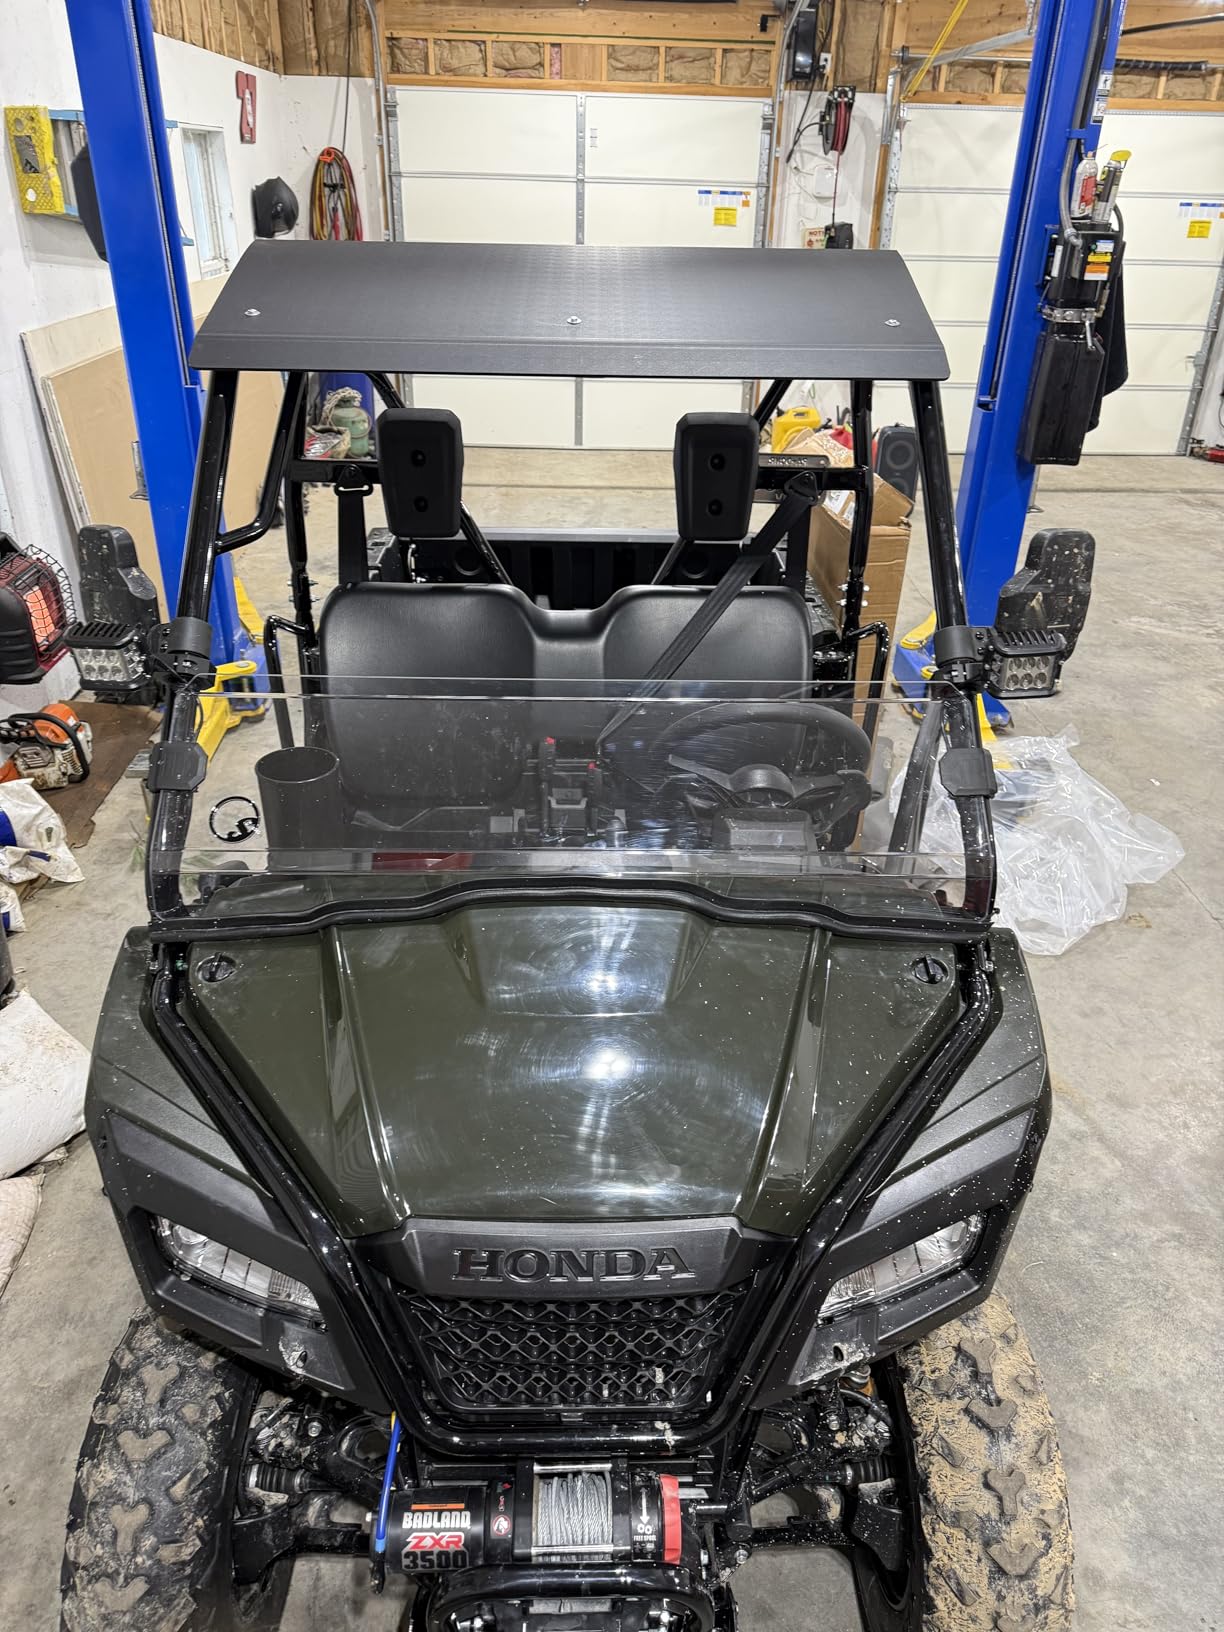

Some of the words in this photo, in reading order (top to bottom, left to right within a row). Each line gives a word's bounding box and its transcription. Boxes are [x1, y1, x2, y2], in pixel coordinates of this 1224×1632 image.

[451, 1247, 697, 1283] HONDA
[402, 1511, 470, 1529] BADLAND
[406, 1532, 465, 1551] ZXR
[403, 1551, 467, 1569] 3500
